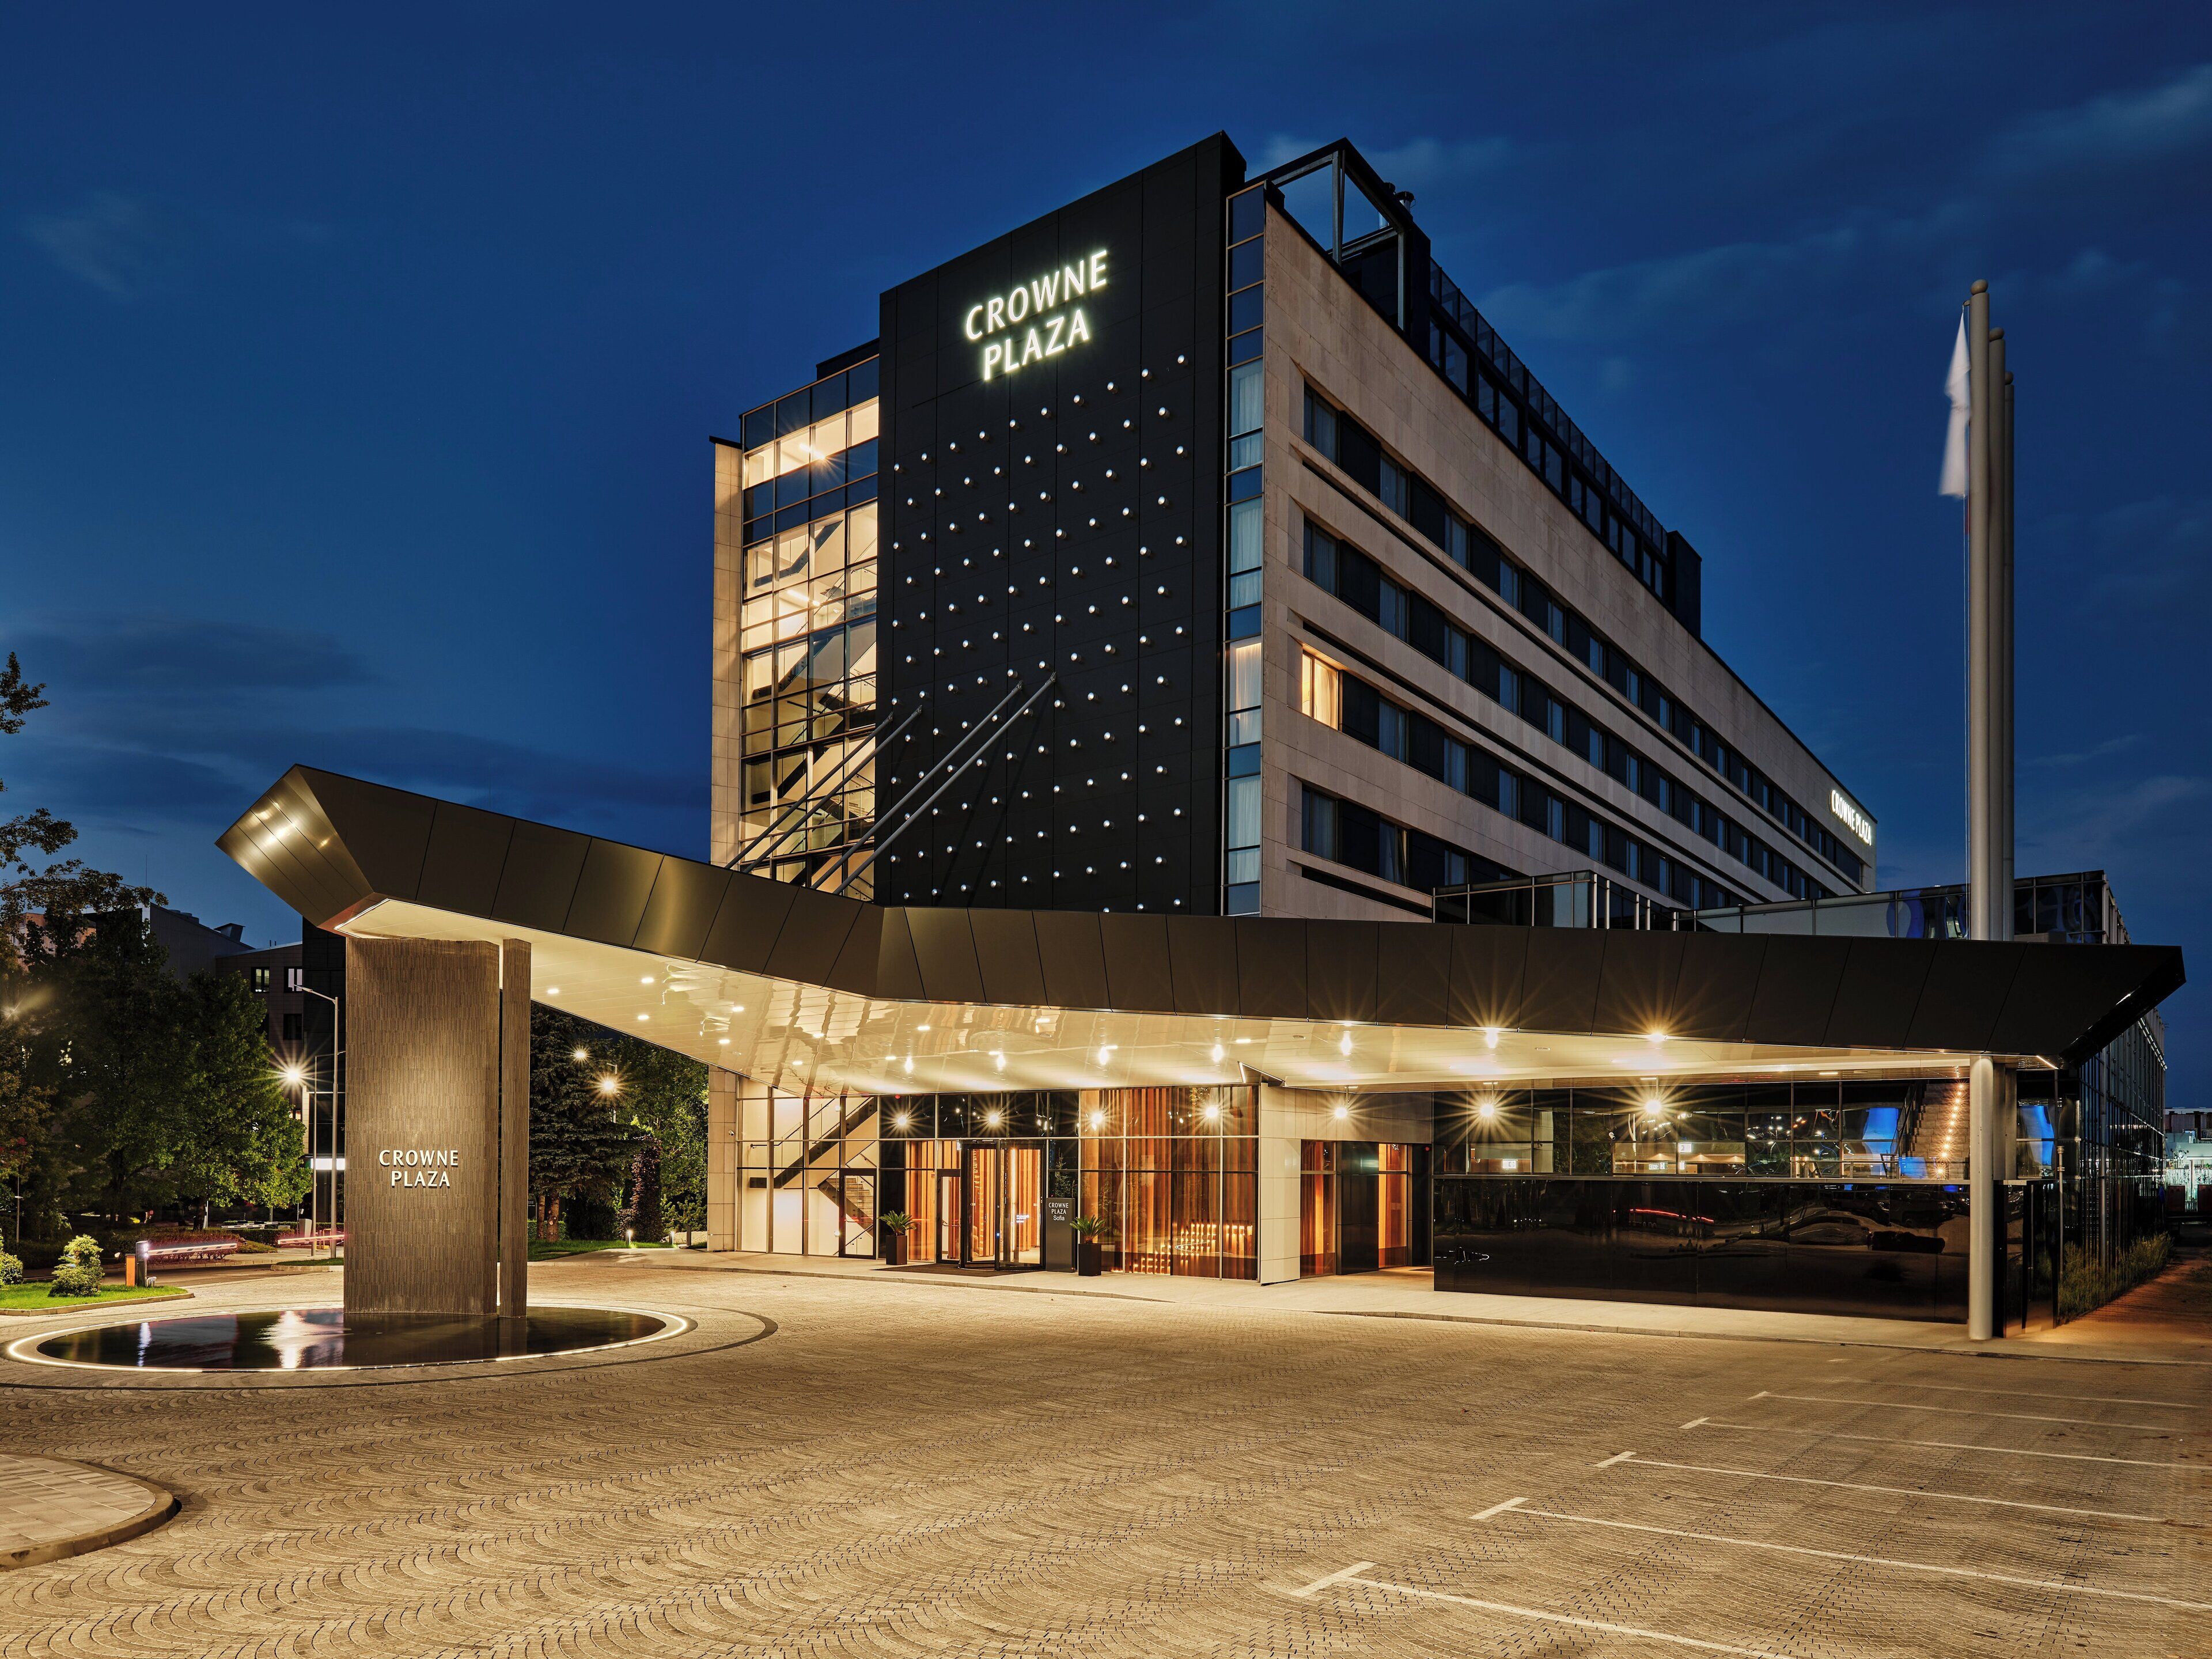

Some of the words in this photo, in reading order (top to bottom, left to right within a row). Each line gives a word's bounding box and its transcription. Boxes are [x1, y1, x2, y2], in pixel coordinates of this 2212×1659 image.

[965, 249, 1107, 340] CROWNE
[984, 309, 1089, 381] PLAZA
[1831, 789, 1855, 831] CROWNE
[1855, 813, 1872, 846] PLAZA
[379, 1150, 459, 1166] CROWNE
[391, 1171, 450, 1188] PLAZA
